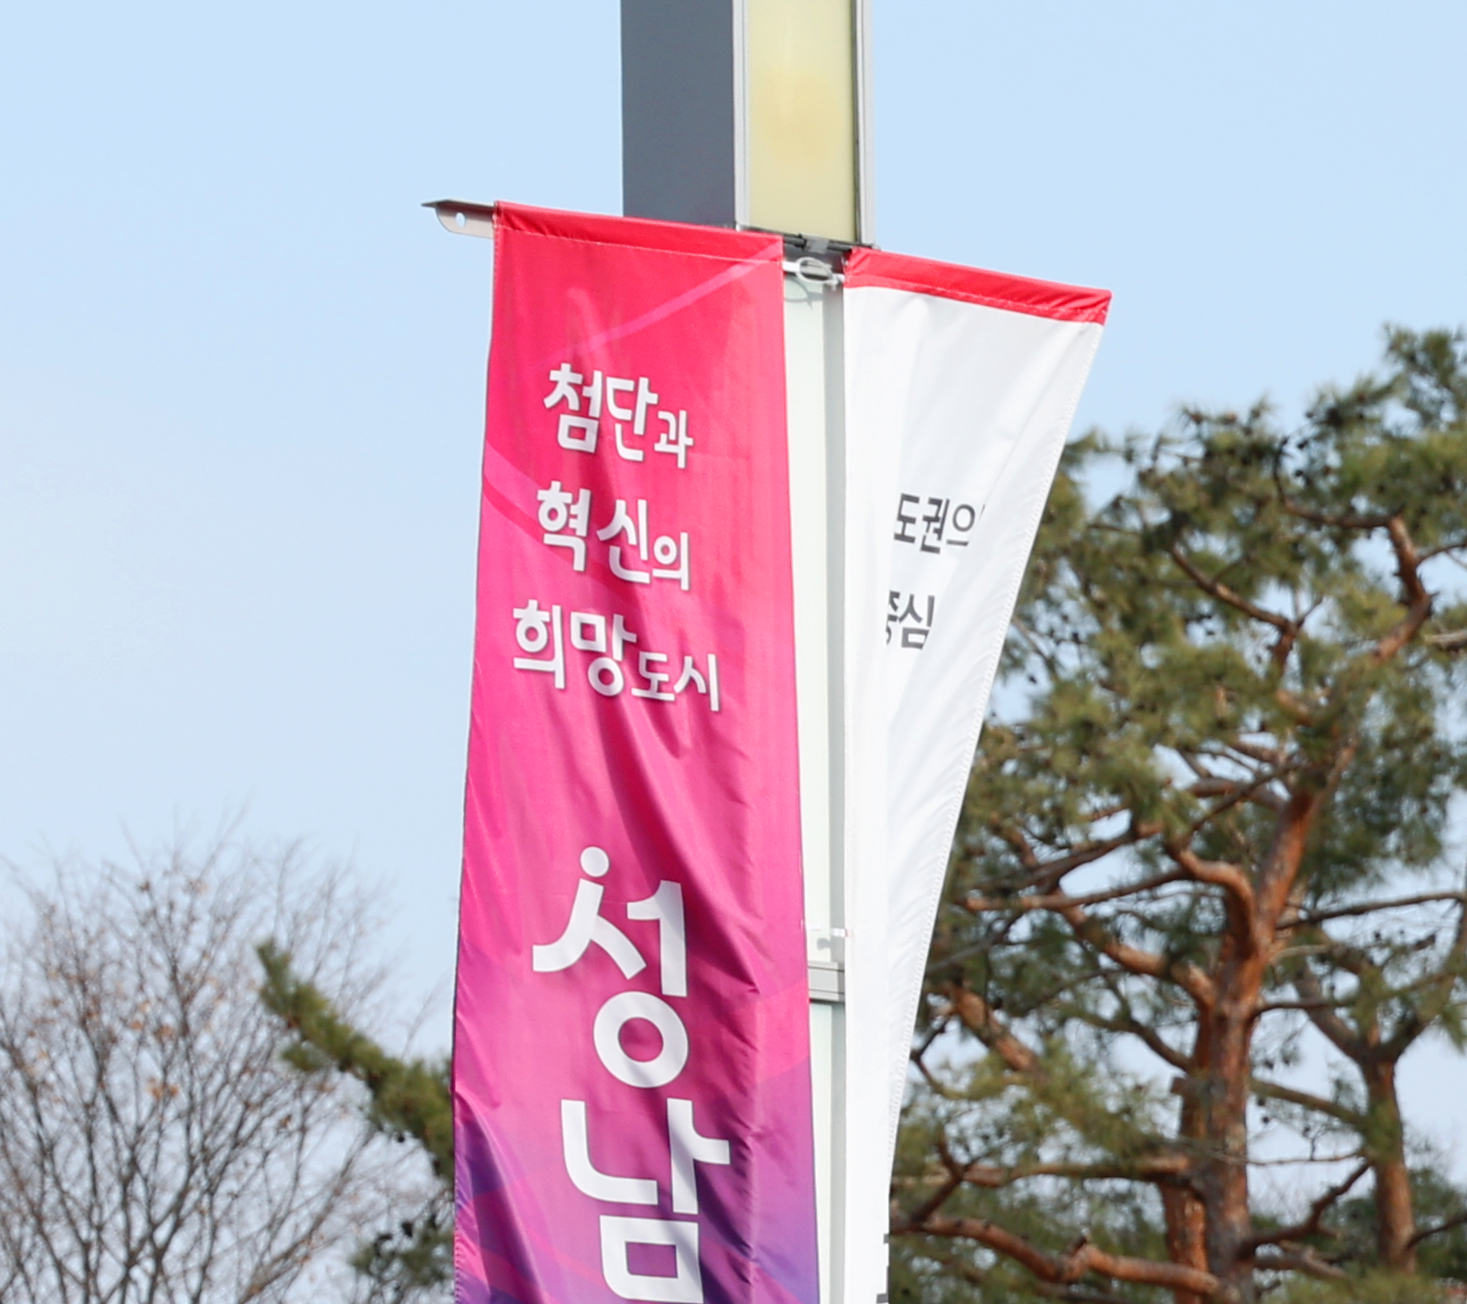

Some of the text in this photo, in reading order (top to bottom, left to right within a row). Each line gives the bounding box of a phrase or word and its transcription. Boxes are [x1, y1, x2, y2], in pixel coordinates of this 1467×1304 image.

[544, 362, 693, 469] 첨단과
[537, 480, 690, 591] 혁신의
[512, 599, 720, 711] 희망도시
[532, 846, 731, 1304] 성남
